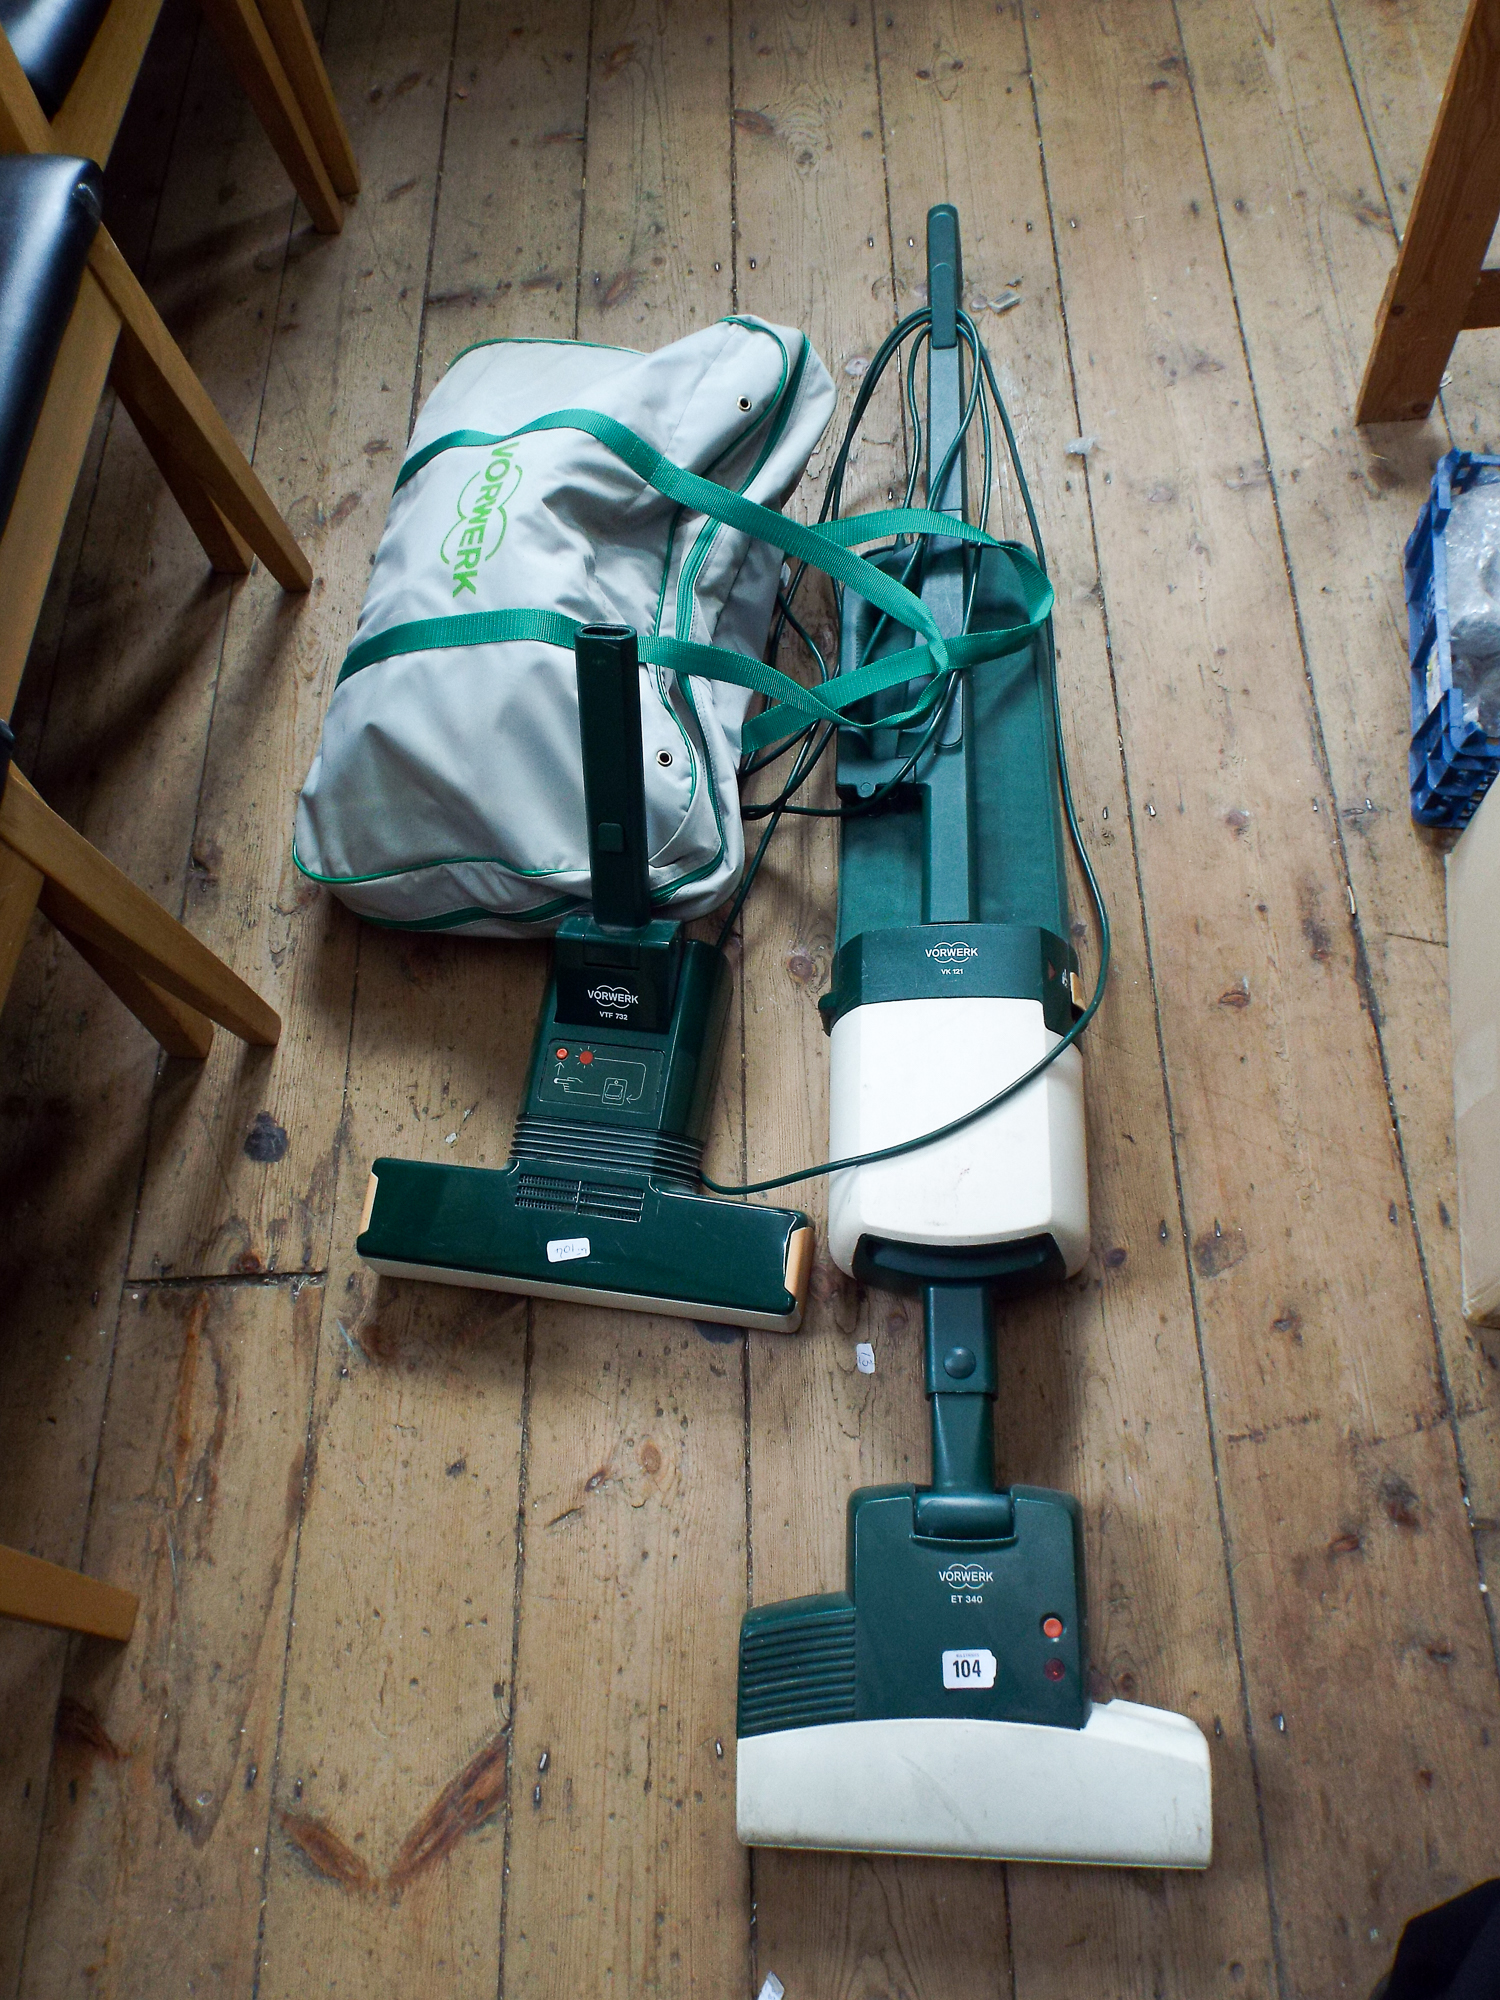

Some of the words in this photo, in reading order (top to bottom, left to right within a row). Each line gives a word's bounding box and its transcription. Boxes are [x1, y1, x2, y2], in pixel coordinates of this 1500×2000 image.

[452, 442, 520, 598] VORWERK
[925, 947, 978, 958] VORWERK
[587, 989, 639, 1005] VORWERK
[599, 1010, 613, 1019] VTF
[615, 1012, 628, 1021] 732
[938, 1570, 994, 1582] VORWERK
[950, 1594, 963, 1604] ET
[965, 1594, 983, 1604] 340
[952, 1659, 982, 1678] 104
